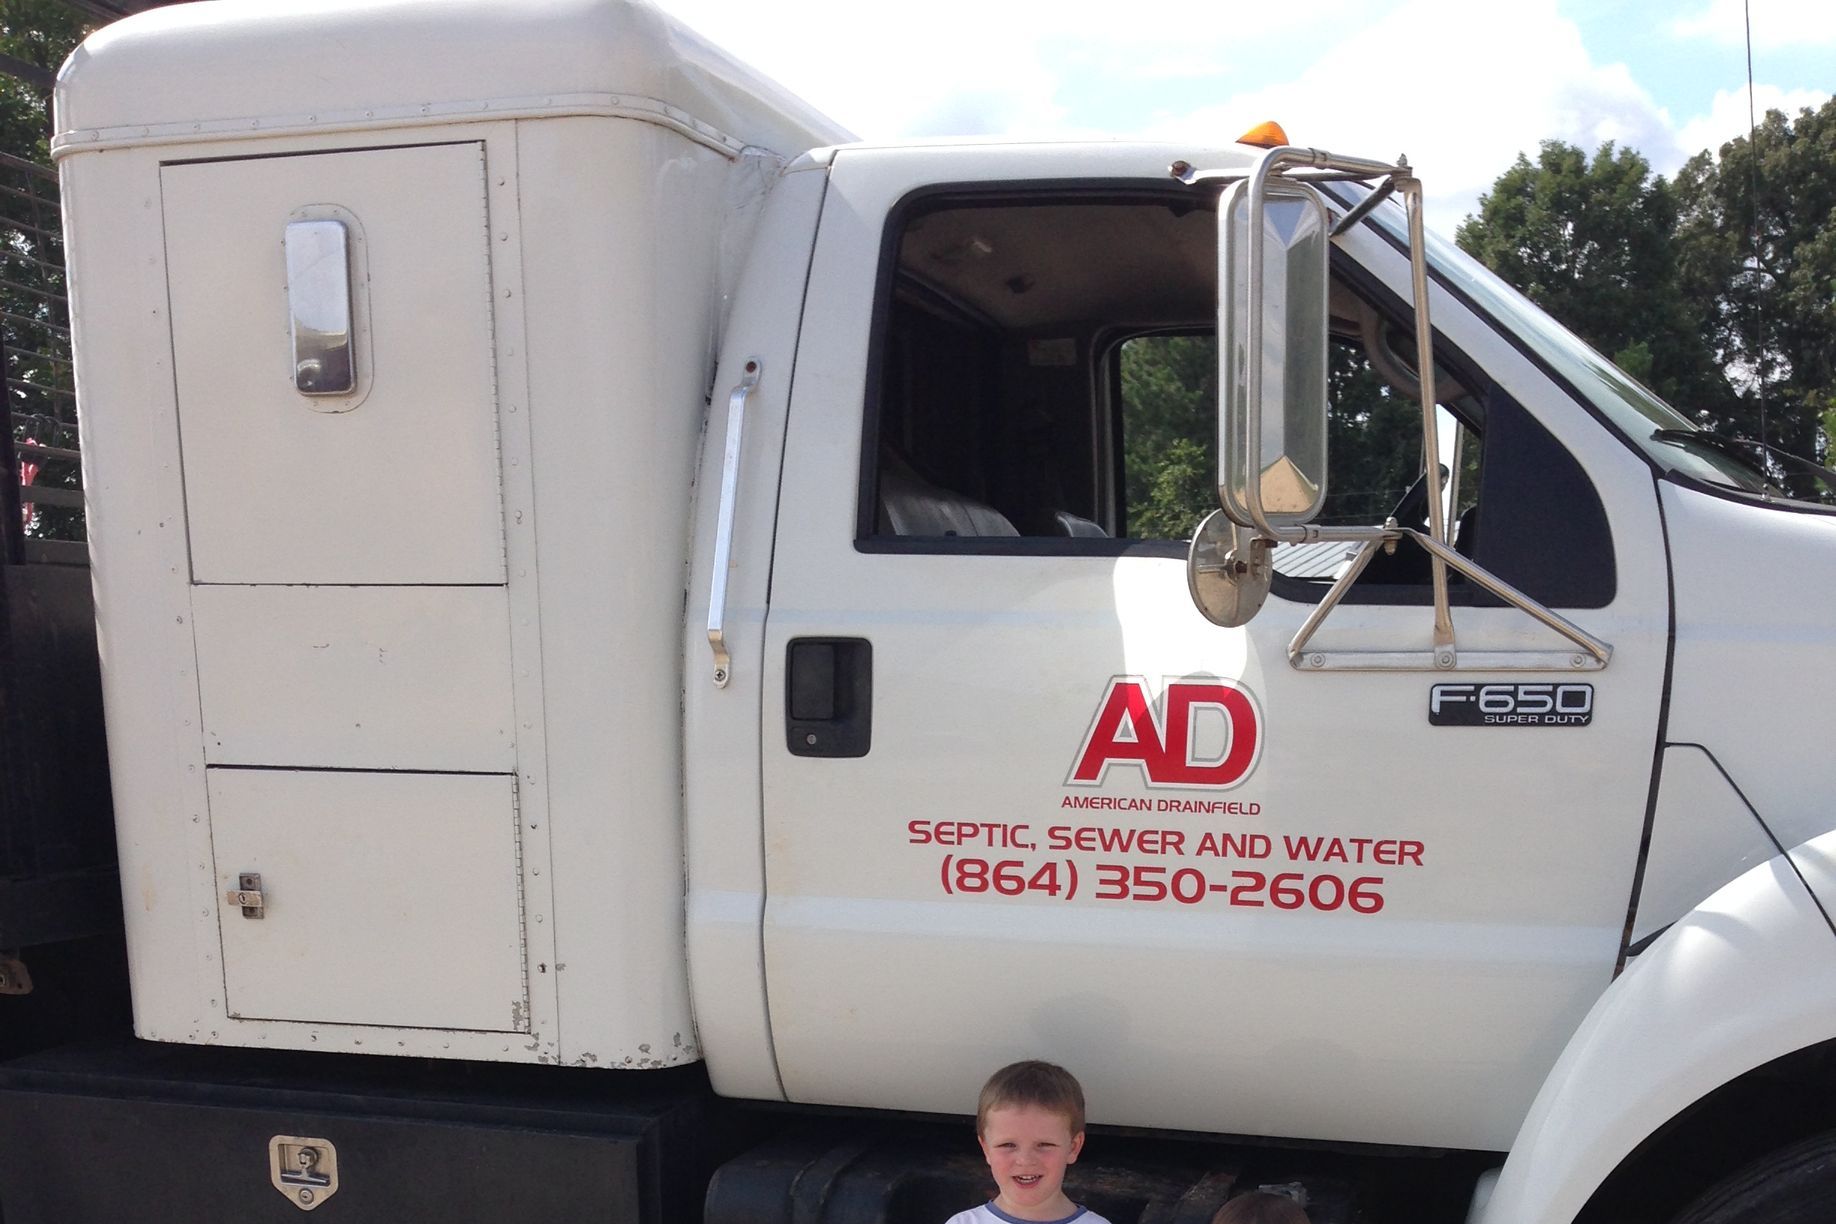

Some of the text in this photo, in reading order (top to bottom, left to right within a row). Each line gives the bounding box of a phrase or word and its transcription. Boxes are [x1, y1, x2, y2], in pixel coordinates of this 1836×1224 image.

[1065, 676, 1264, 788] AD
[1484, 715, 1589, 724] SUPER DUTY
[1061, 796, 1261, 815] AMERICAN DRAINFIELD
[907, 820, 1425, 866] SEPTIC, SEWER AND WATER
[940, 854, 1385, 915] (864) 350-2606
